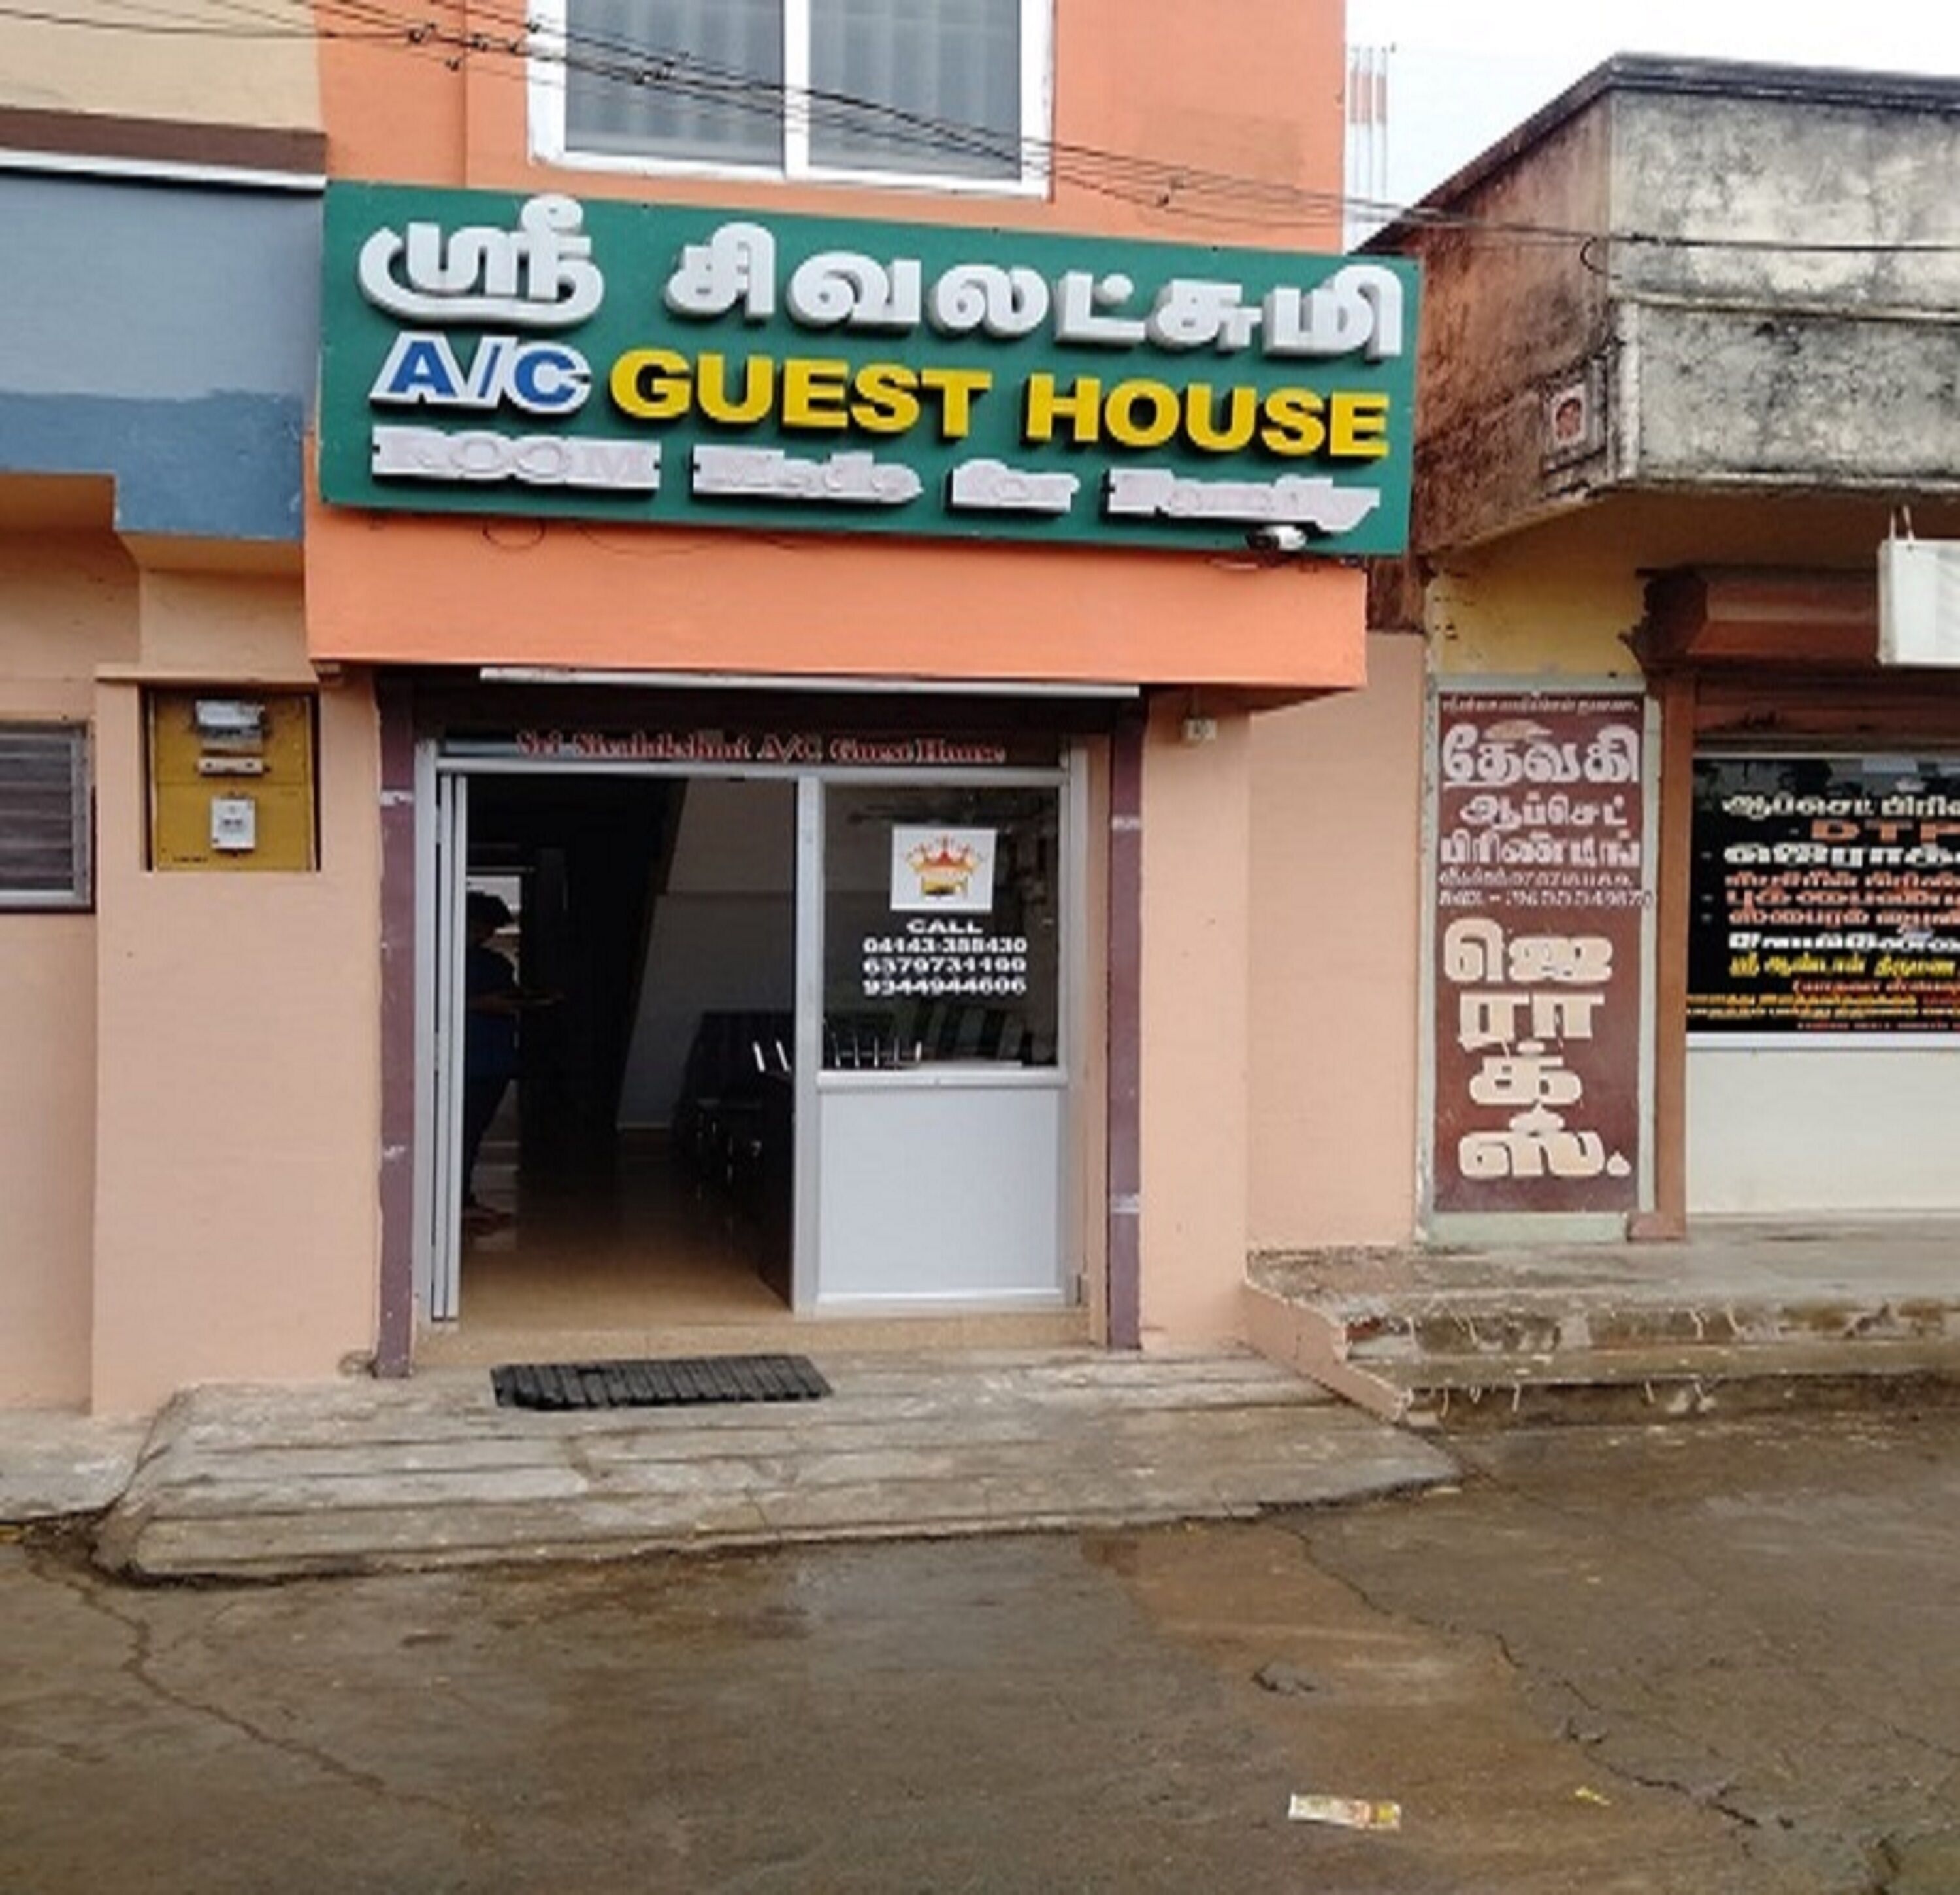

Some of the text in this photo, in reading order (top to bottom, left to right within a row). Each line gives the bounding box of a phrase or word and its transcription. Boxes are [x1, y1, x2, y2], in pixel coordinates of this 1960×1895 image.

[359, 193, 1402, 359] ஸ்ரீ சிவலட்சுமி
[369, 331, 1389, 459] A/C GUEST HOUSE
[372, 425, 661, 490] ROOM
[1442, 723, 1639, 789] தேவகி
[1459, 791, 1628, 831] ஆப்செட்
[906, 919, 983, 934] CALL
